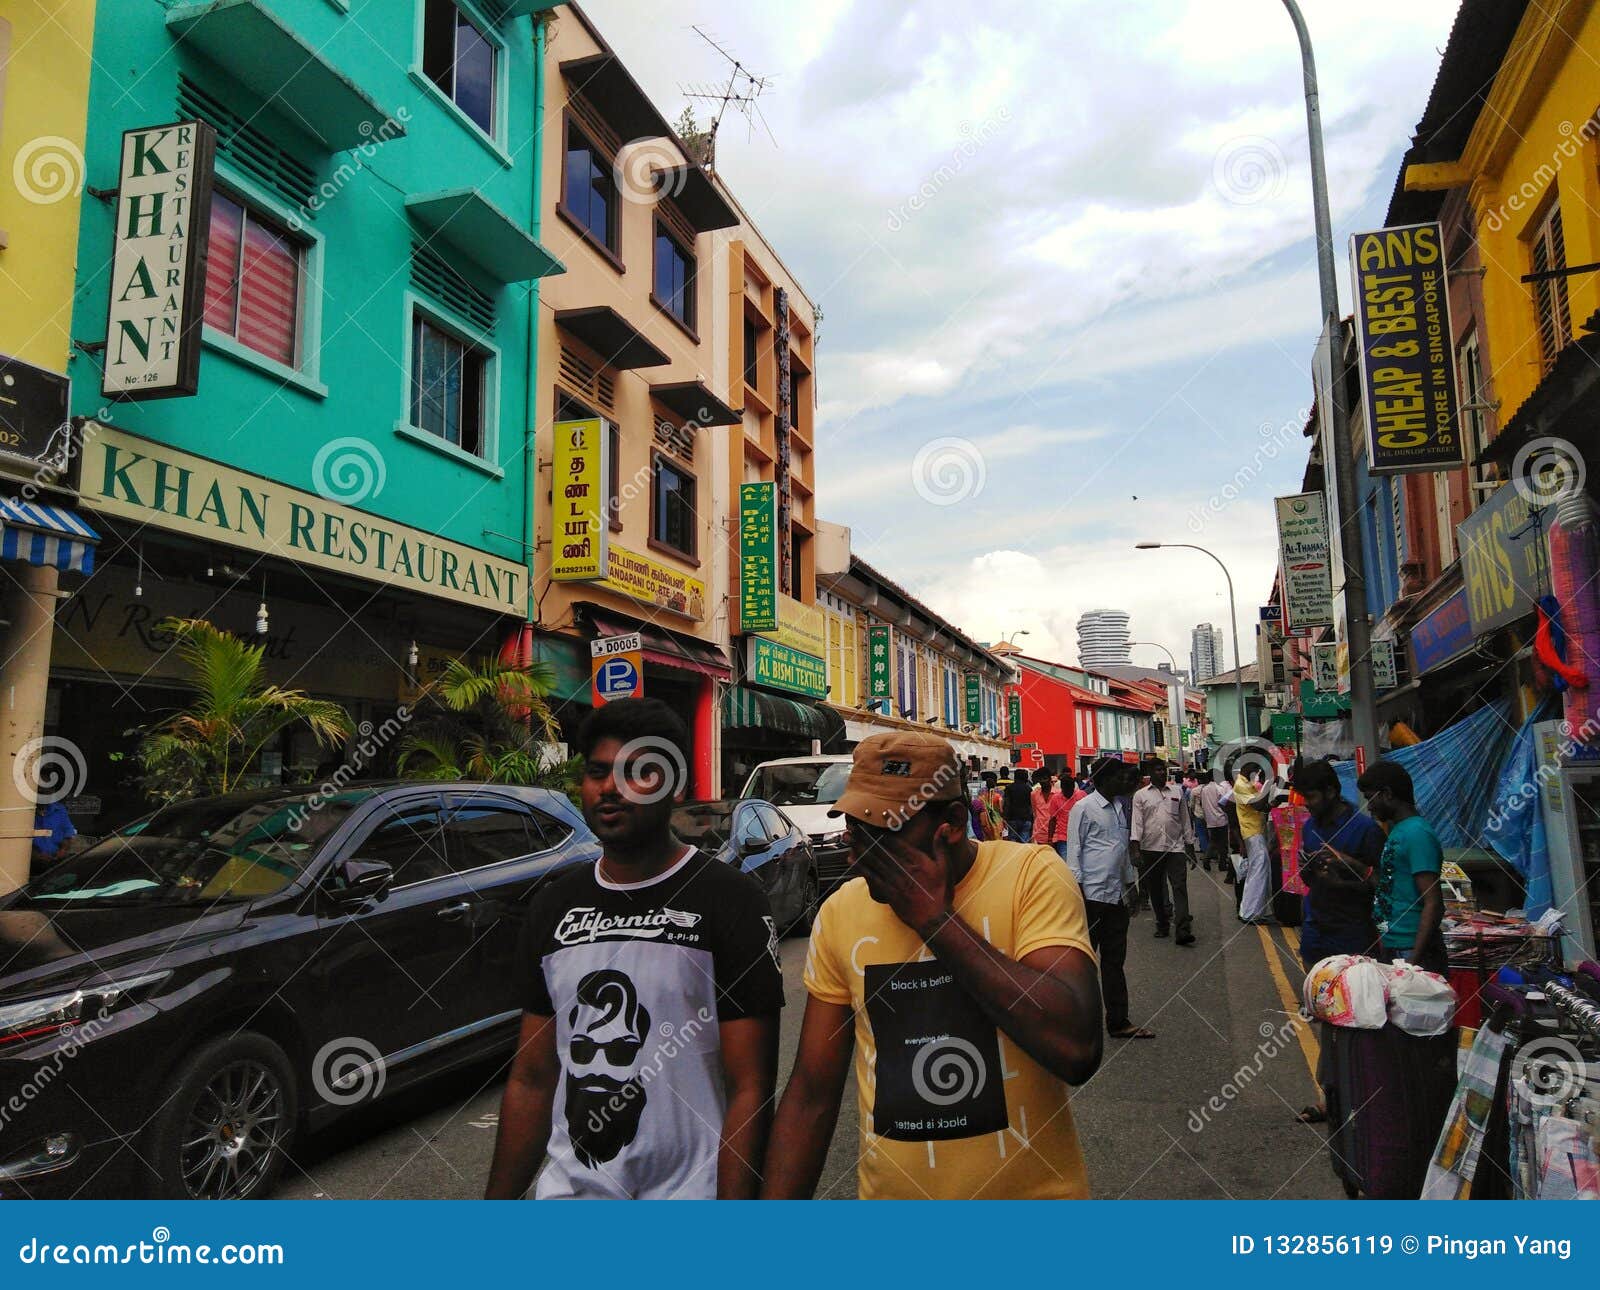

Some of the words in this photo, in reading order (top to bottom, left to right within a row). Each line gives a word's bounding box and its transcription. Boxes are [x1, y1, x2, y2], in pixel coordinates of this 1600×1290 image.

[111, 130, 172, 366] KHAN
[161, 127, 191, 361] RESTAURANT
[1359, 228, 1439, 273] ANS
[1364, 273, 1418, 335] BEST
[1422, 270, 1444, 363] SINGAPORE
[1370, 338, 1420, 358] &
[143, 373, 158, 382] 126
[1432, 368, 1446, 385] IN
[1373, 367, 1429, 450] CHEAP
[1433, 389, 1453, 445] STORE
[742, 487, 757, 500] AL
[97, 443, 270, 539] KHAN
[287, 501, 519, 605] RESTAURANT
[743, 510, 759, 546] BISMI
[743, 555, 760, 617] TEXTILES
[1466, 510, 1515, 623] ANS
[605, 661, 633, 692] P
[758, 656, 770, 677] AL
[772, 660, 794, 683] BISMI
[795, 667, 825, 692] TEXTILES
[891, 979, 918, 991] black
[920, 978, 927, 988] is
